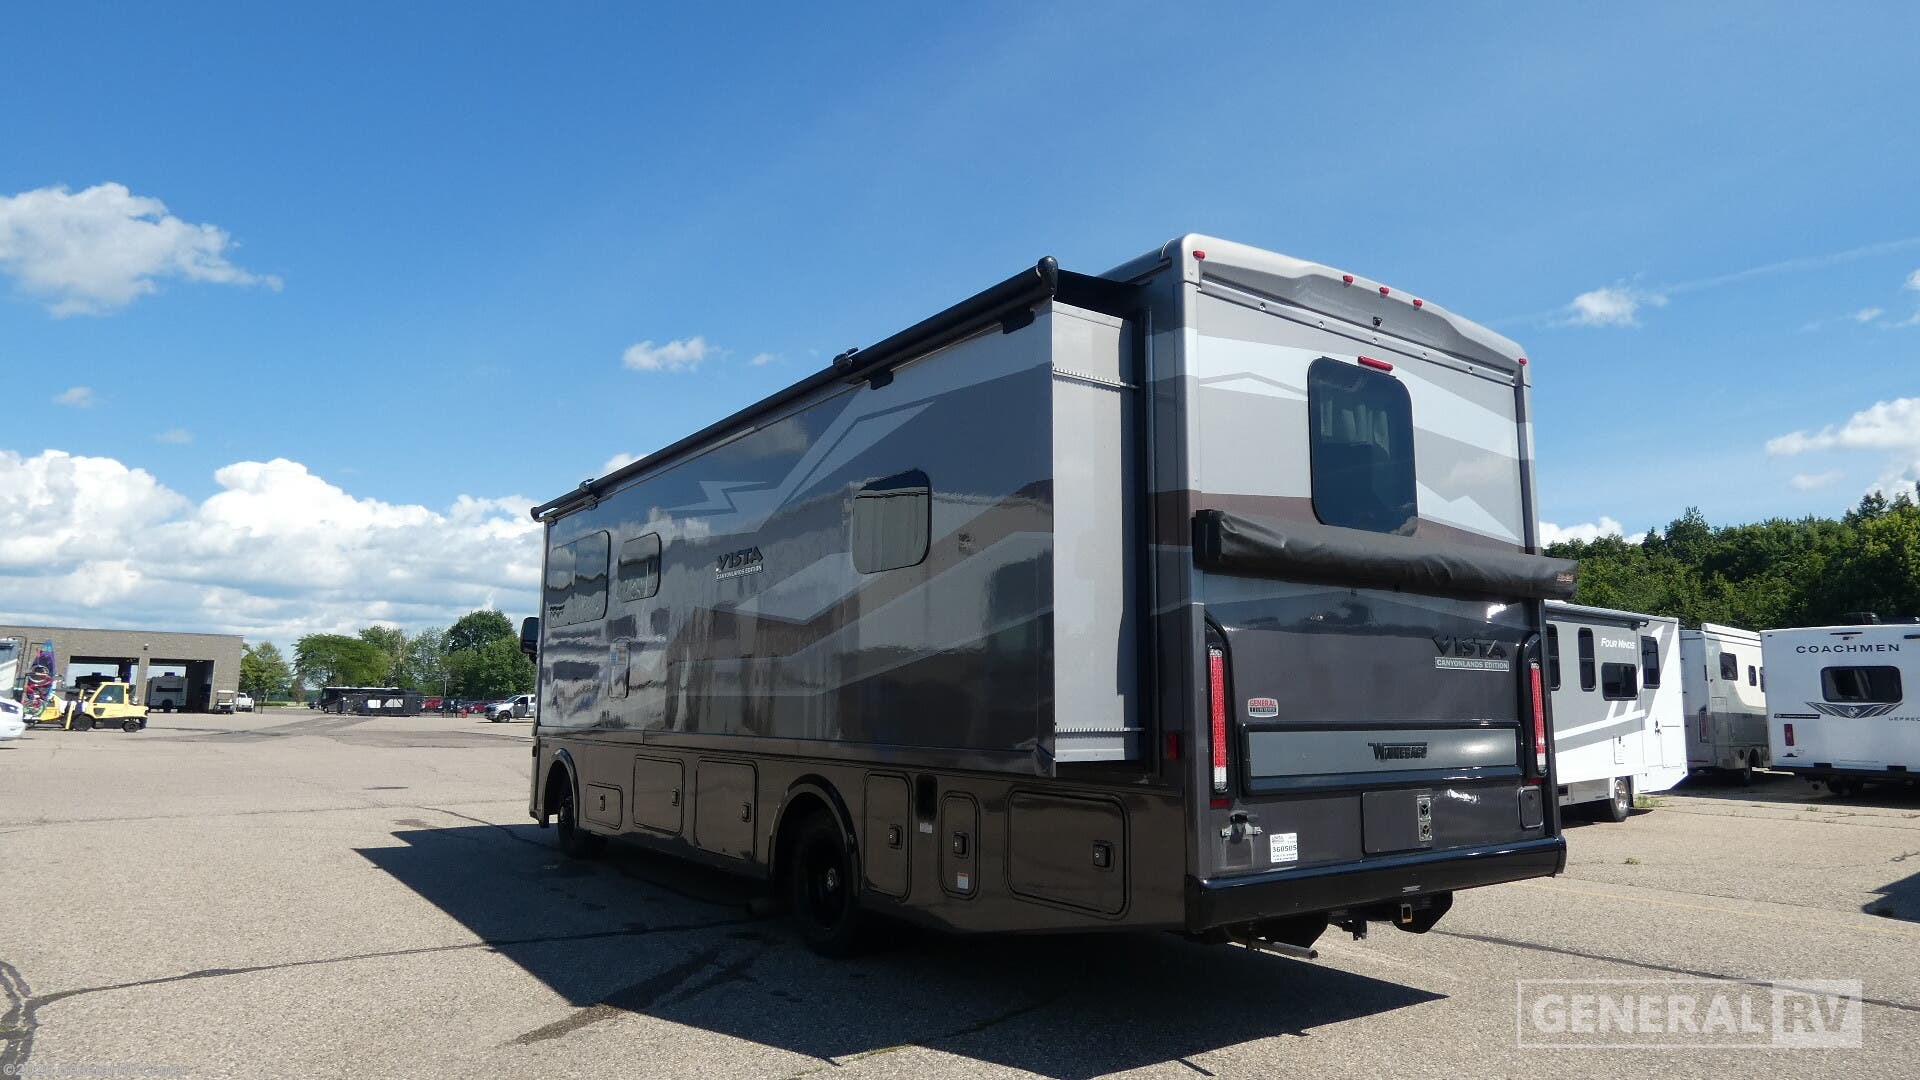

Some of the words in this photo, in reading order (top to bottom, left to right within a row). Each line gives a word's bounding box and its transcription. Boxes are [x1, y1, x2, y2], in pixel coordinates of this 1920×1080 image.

[717, 546, 763, 570] VISTA
[1432, 635, 1507, 657] VISTA
[1796, 644, 1900, 653] COACHMEN
[1436, 659, 1483, 668] CANYONLANDS
[1484, 662, 1508, 670] EDITION
[1249, 699, 1277, 707] GENERAL
